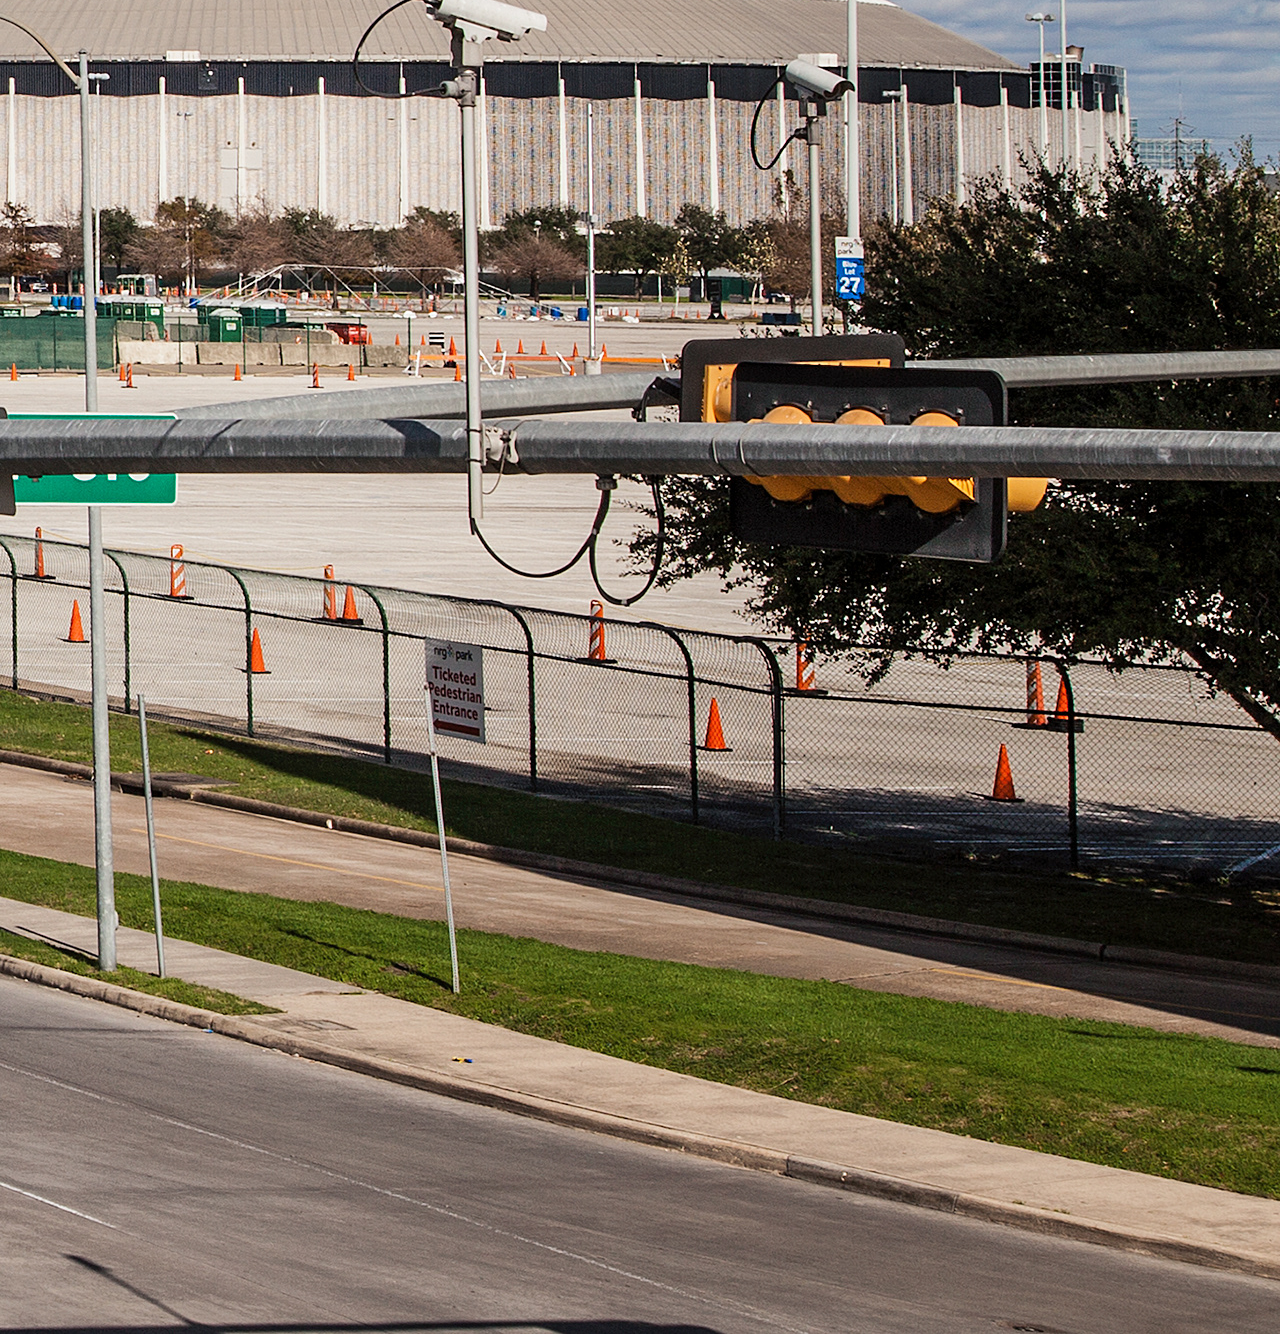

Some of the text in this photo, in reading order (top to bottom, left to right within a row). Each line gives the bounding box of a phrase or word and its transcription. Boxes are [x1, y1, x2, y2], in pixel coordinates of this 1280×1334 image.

[840, 277, 860, 293] 27
[433, 647, 473, 662] nrg park
[432, 666, 476, 686] Ticketed
[428, 681, 482, 704] Pedestrian
[433, 699, 478, 721] Entrance
